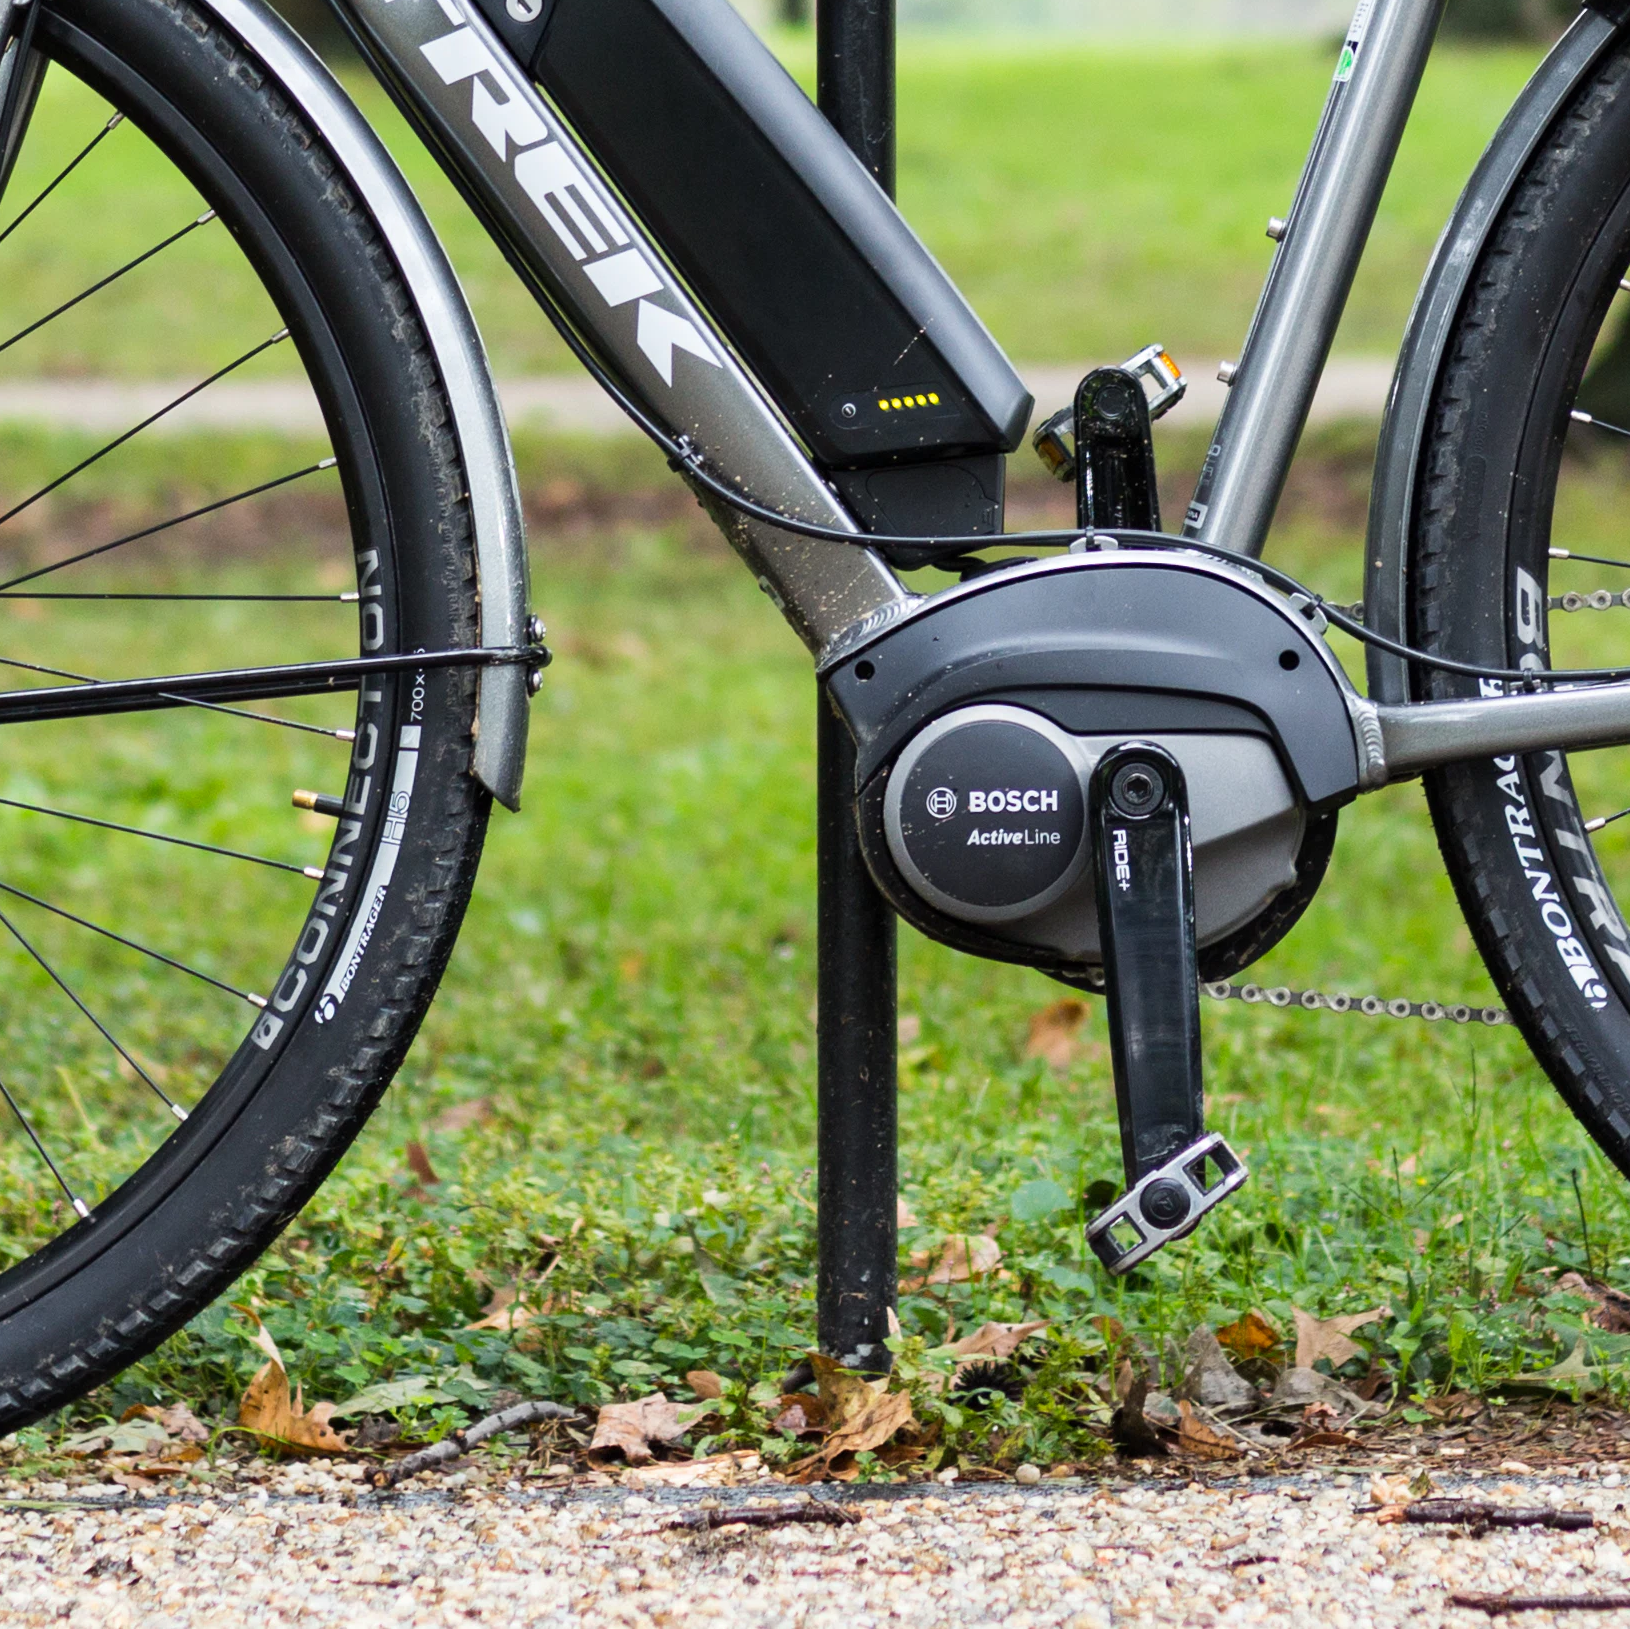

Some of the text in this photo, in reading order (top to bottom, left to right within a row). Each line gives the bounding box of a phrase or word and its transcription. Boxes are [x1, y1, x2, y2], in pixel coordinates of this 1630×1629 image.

[410, 648, 426, 722] 700x
[273, 548, 385, 1012] CONNECTON
[968, 789, 1058, 813] BOSCH
[1111, 829, 1131, 892] RIDE+
[339, 885, 387, 993] BONTRAGER
